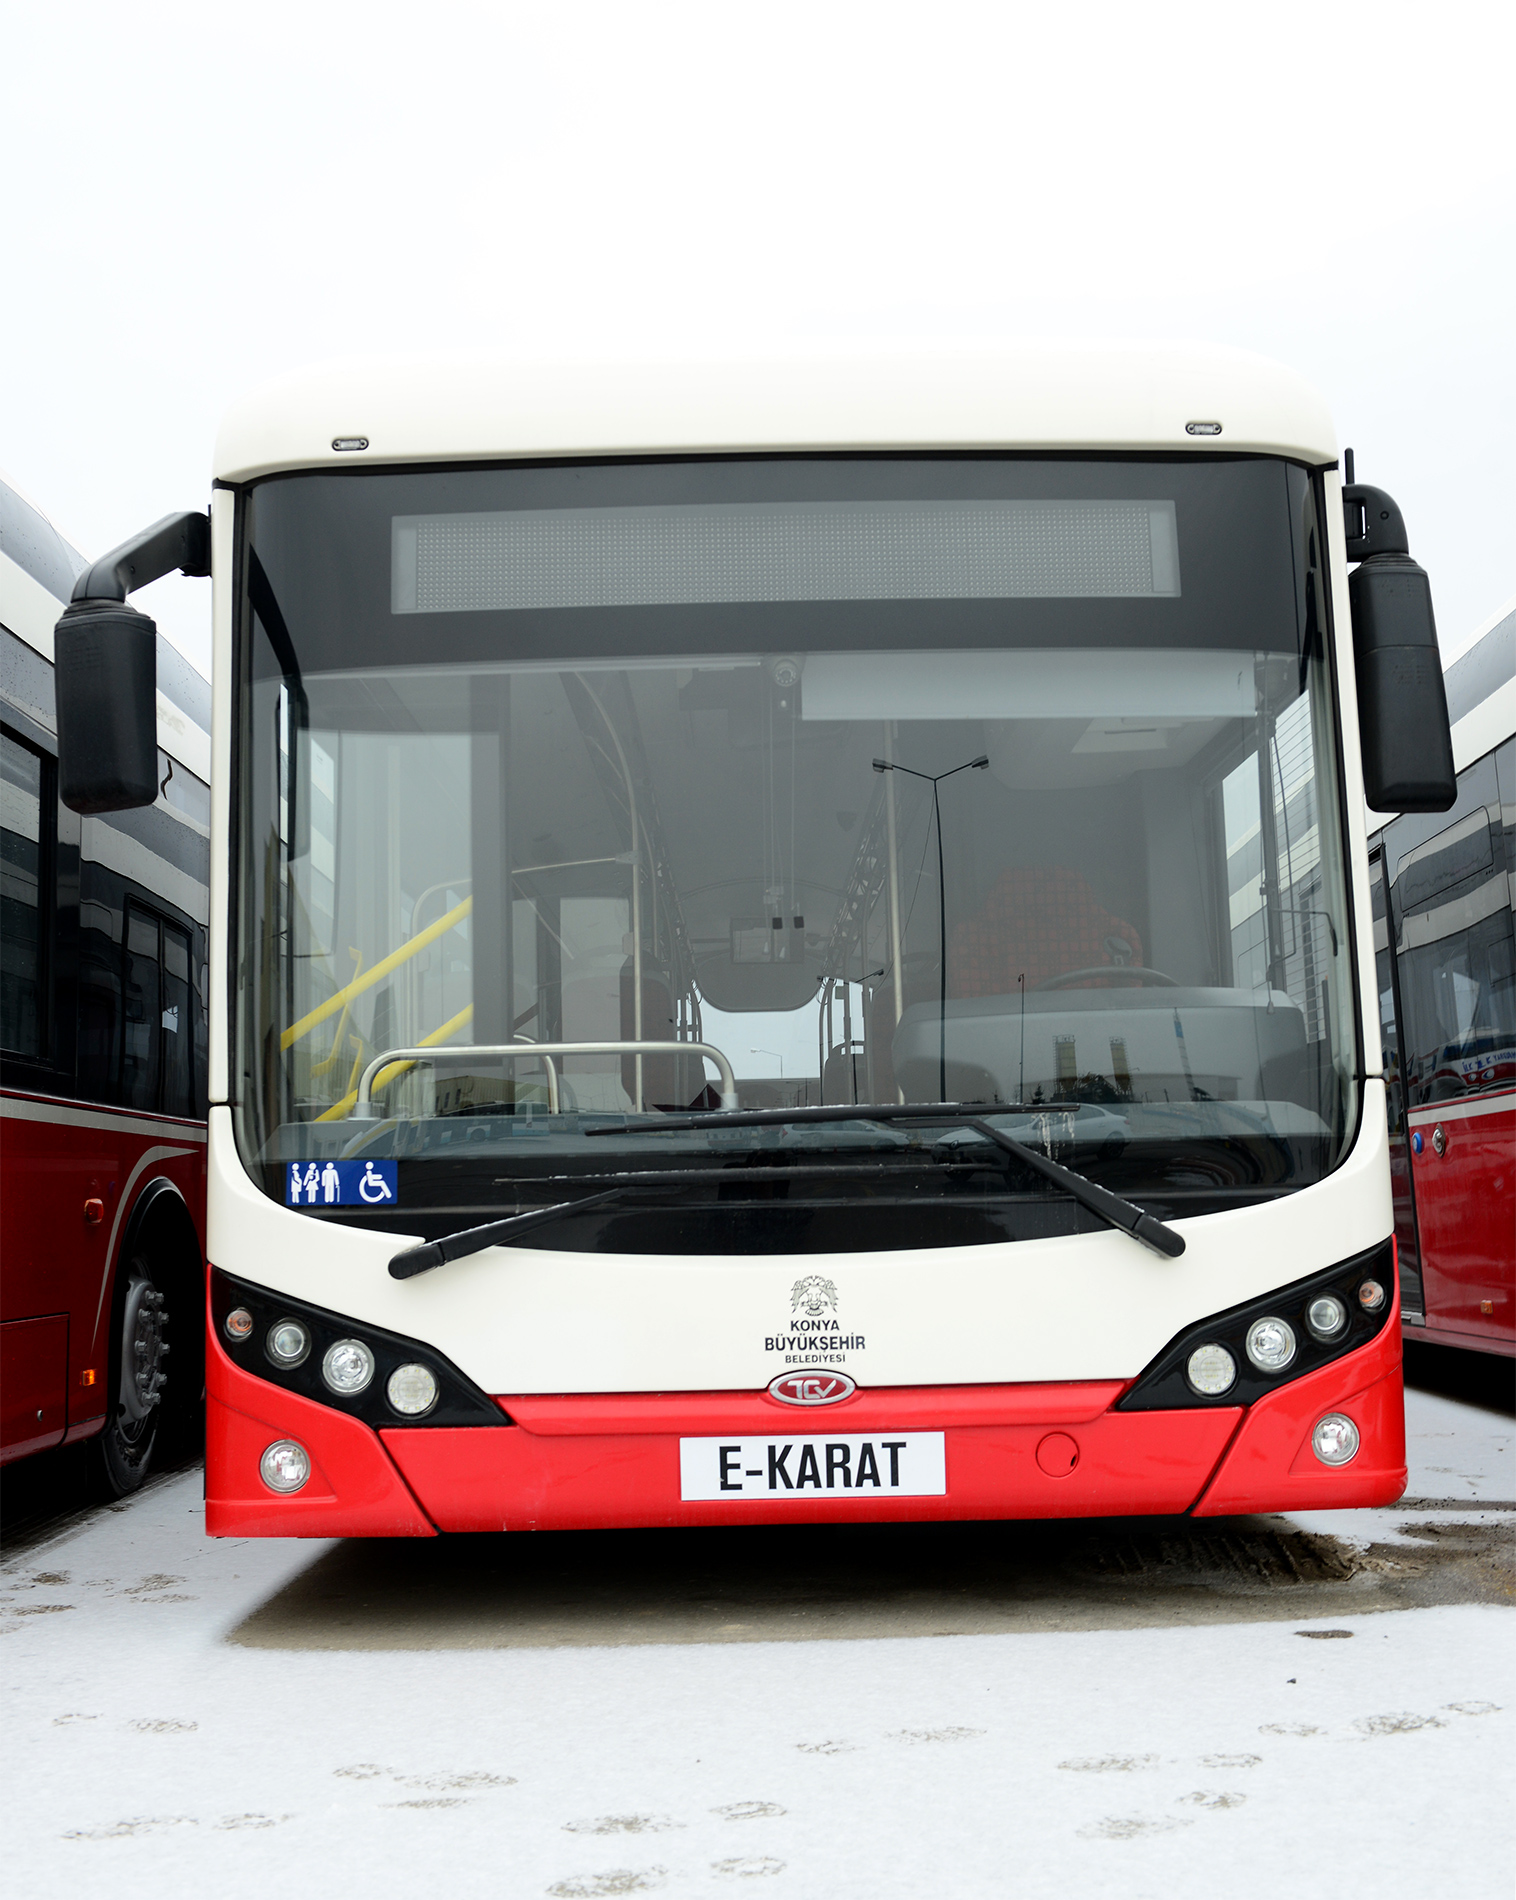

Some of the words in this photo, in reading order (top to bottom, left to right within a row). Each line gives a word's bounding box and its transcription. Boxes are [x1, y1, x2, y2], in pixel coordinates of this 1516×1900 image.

[790, 1320, 840, 1331] KONYA
[764, 1332, 866, 1352] BÜYÜKŞEHİR
[785, 1352, 846, 1363] BELEDİYESİ
[787, 1379, 837, 1400] TCV
[719, 1441, 907, 1491] E-KARAT
